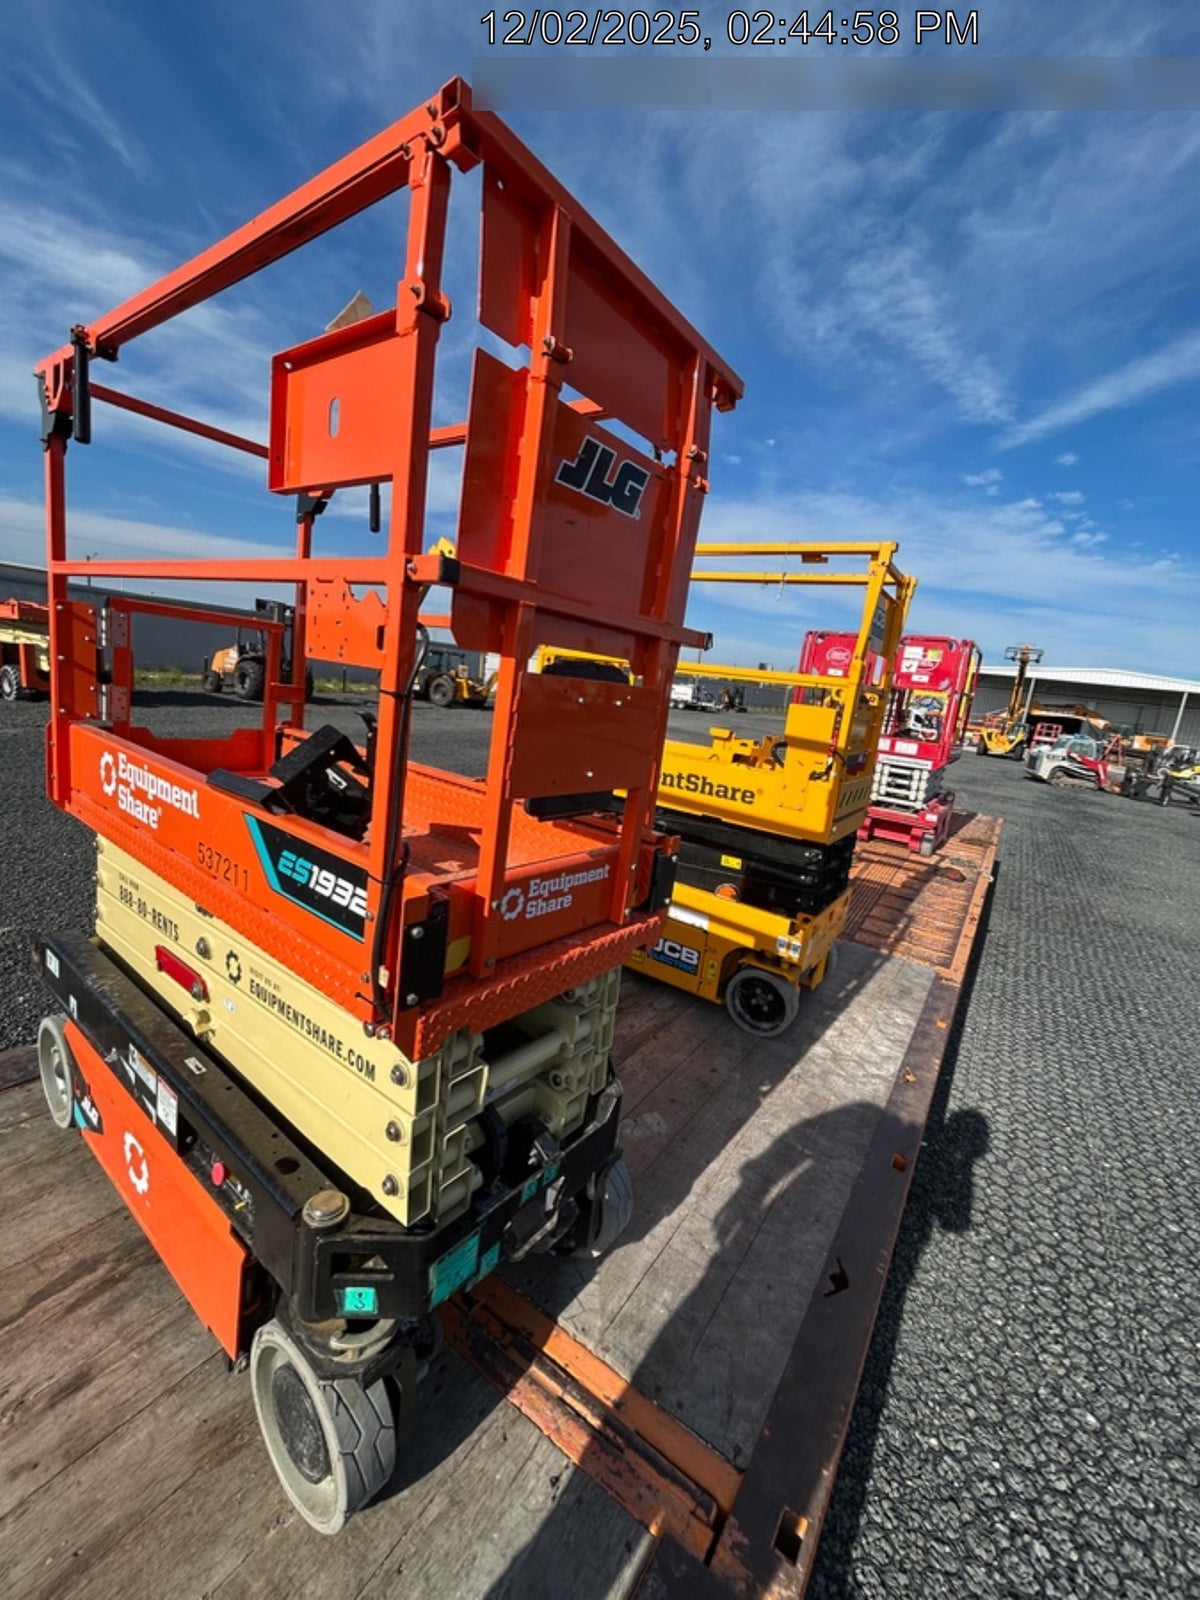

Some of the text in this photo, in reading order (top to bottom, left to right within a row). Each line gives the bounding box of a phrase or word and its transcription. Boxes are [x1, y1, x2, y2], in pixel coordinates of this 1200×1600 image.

[554, 435, 651, 520] JLG
[117, 751, 200, 819] Equipment
[117, 784, 159, 830] Share
[660, 771, 756, 805] ntShare
[198, 842, 249, 892] 537211
[277, 849, 368, 919] ES1932
[527, 864, 611, 898] Equipment
[119, 884, 179, 942] 888-80-RENTS
[524, 894, 574, 919] Share
[653, 937, 700, 965] JCB
[249, 978, 377, 1082] EQUIPMENTSHARE.COM
